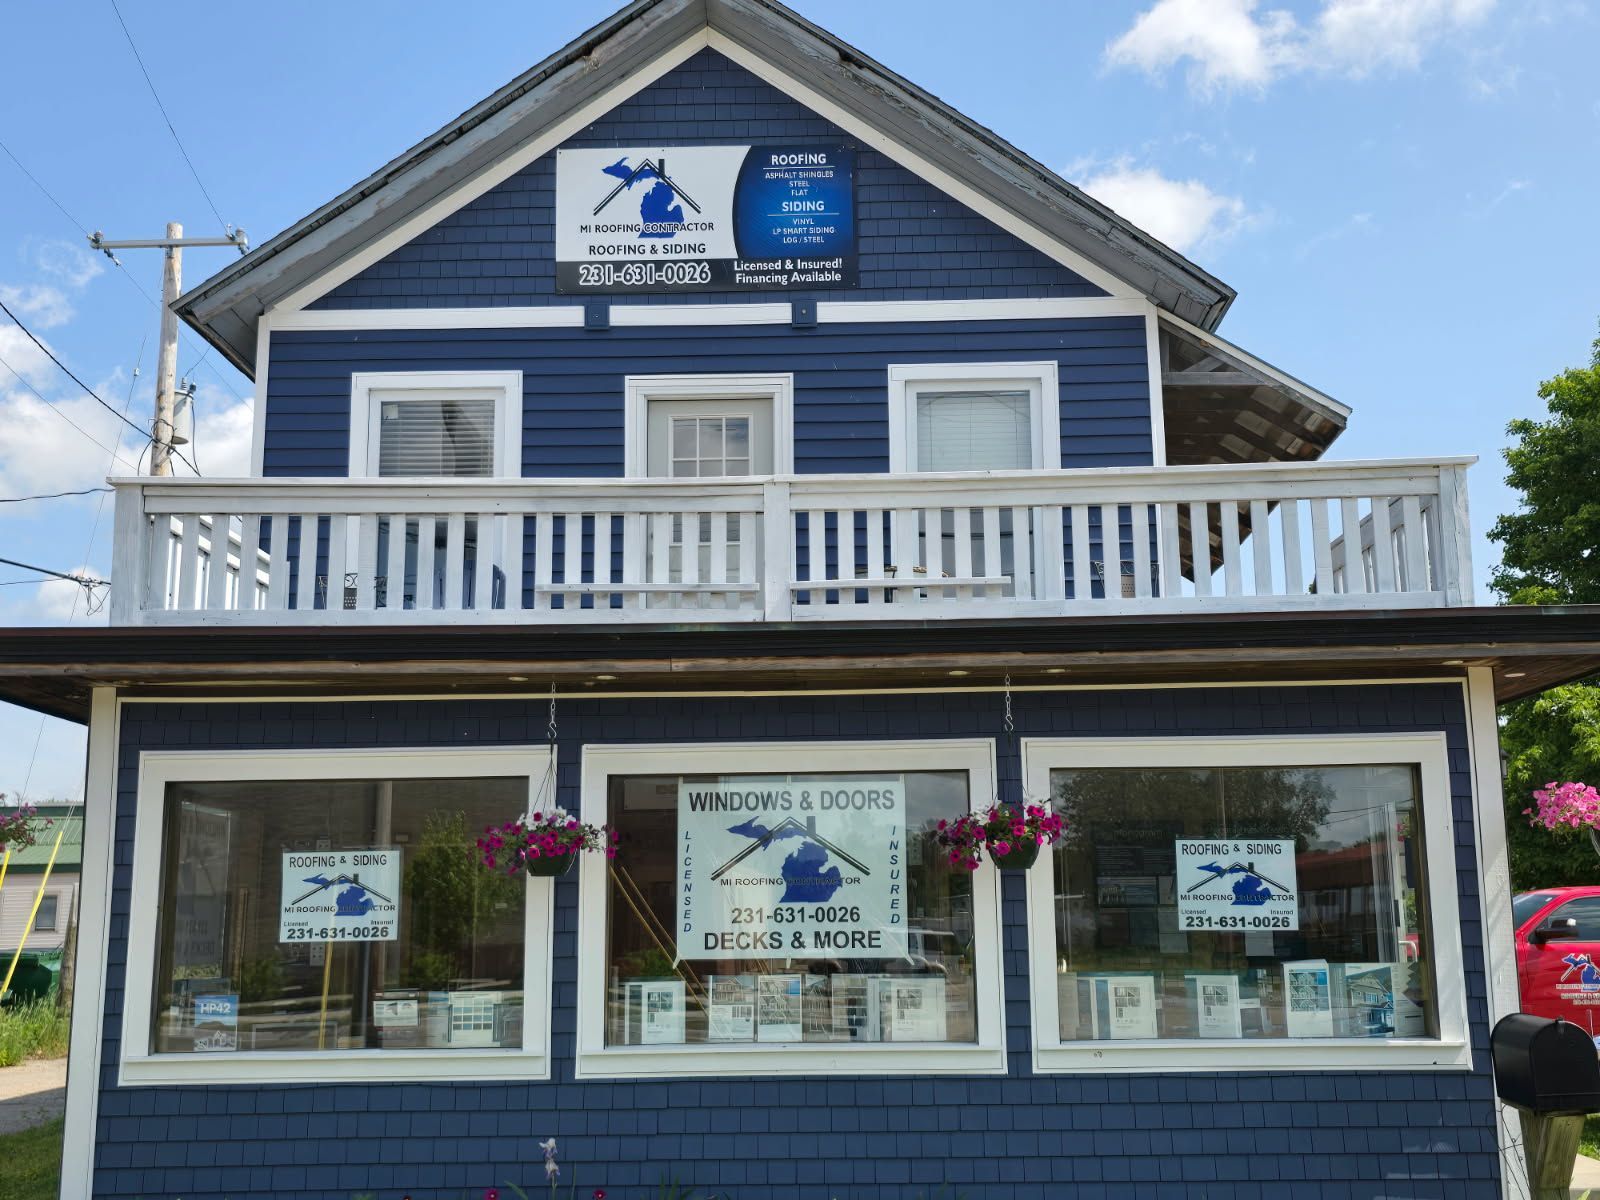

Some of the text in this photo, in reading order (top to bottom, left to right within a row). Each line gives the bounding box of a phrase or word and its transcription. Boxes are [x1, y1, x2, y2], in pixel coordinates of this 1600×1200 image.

[771, 153, 827, 165] ROOFING
[765, 170, 833, 179] ASPHALT SHINGLES
[782, 200, 825, 212] SIDING
[580, 222, 714, 233] MI ROOFING CONTRACTOR
[809, 226, 835, 234] SIDING
[589, 243, 706, 256] ROOFING & SIDING
[733, 257, 842, 271] Licensed & Insured!
[579, 262, 711, 286] 231-631-0026
[735, 271, 842, 286] Financing Available
[689, 789, 895, 812] WINDOWS & DOORS
[1181, 843, 1282, 855] ROOFING & SIDING
[289, 854, 387, 868] ROOFING & SIDING
[889, 825, 901, 924] INSURED
[683, 831, 693, 933] LICENSED
[735, 878, 784, 886] ROOFING
[731, 906, 861, 924] 231-631-0026
[1185, 916, 1290, 928] 231-631-0026
[287, 926, 389, 939] 231-631-0026
[704, 930, 882, 950] DECKS & MORE
[200, 1003, 231, 1014] HP42
